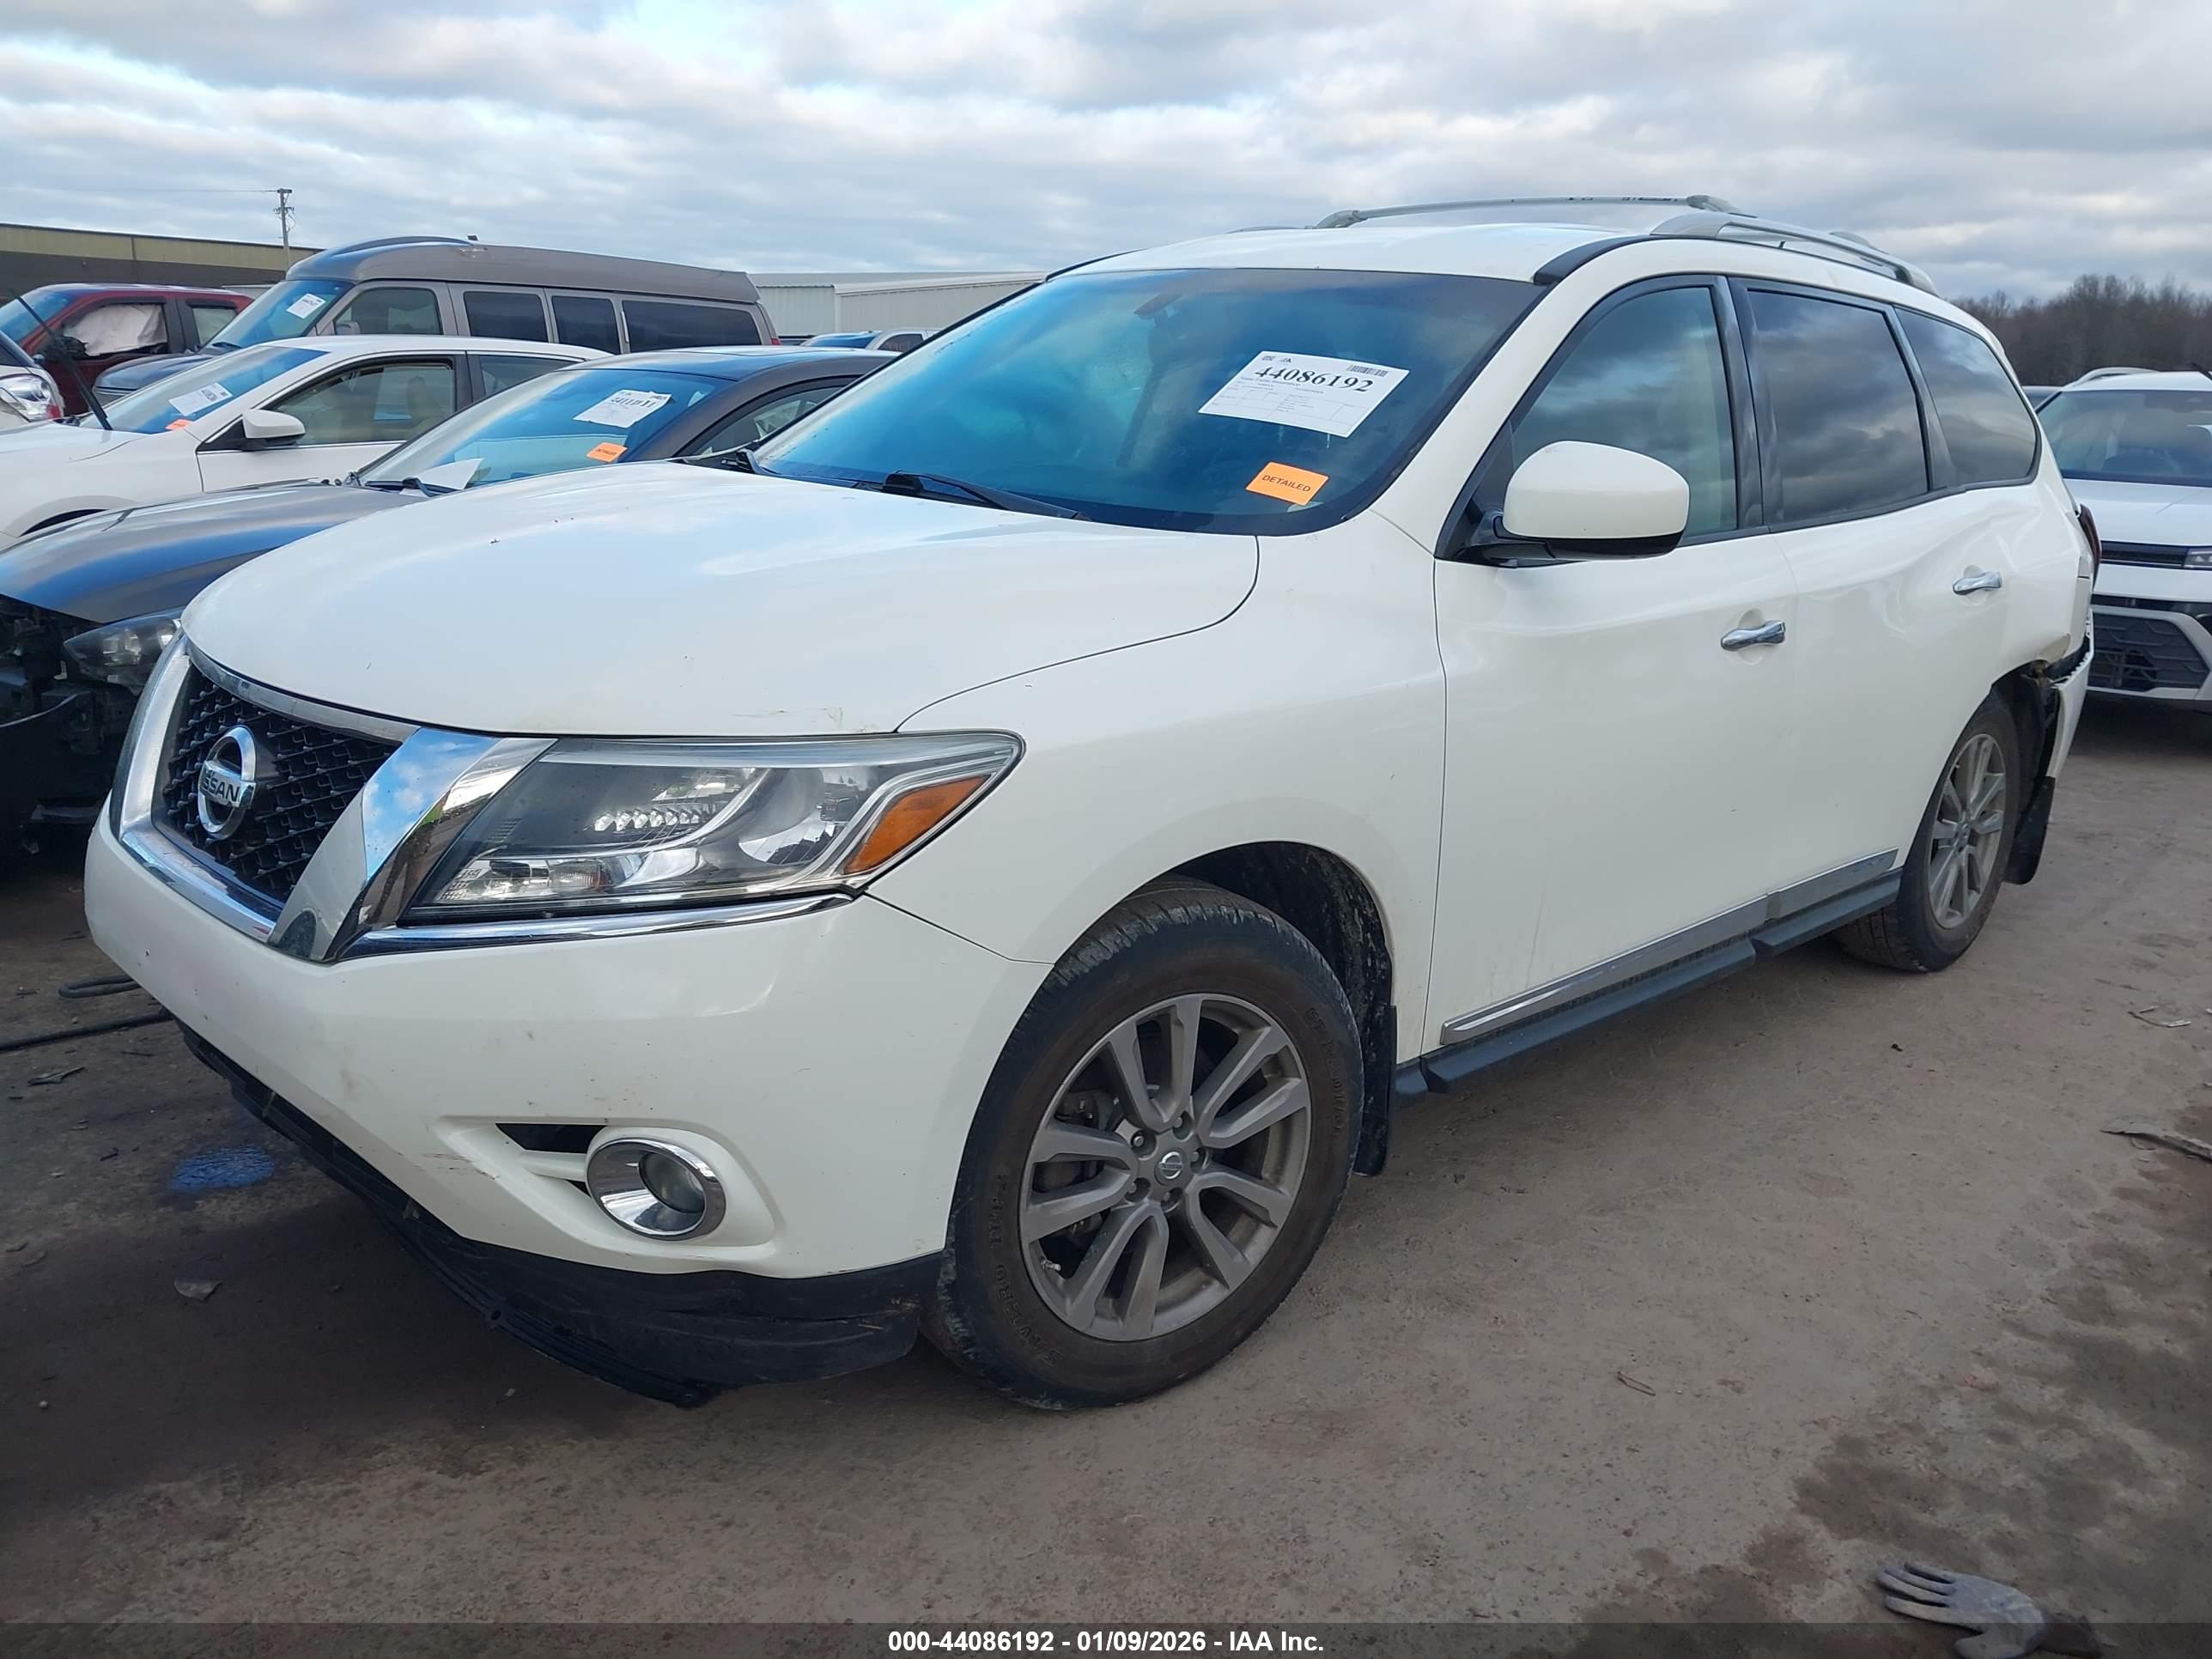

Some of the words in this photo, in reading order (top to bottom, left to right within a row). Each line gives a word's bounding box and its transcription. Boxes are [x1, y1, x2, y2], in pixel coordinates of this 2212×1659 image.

[1254, 364, 1375, 392] 44086192
[1261, 474, 1311, 493] DETAILED
[202, 769, 241, 802] SSAN
[994, 1264, 1065, 1368] SAVERO
